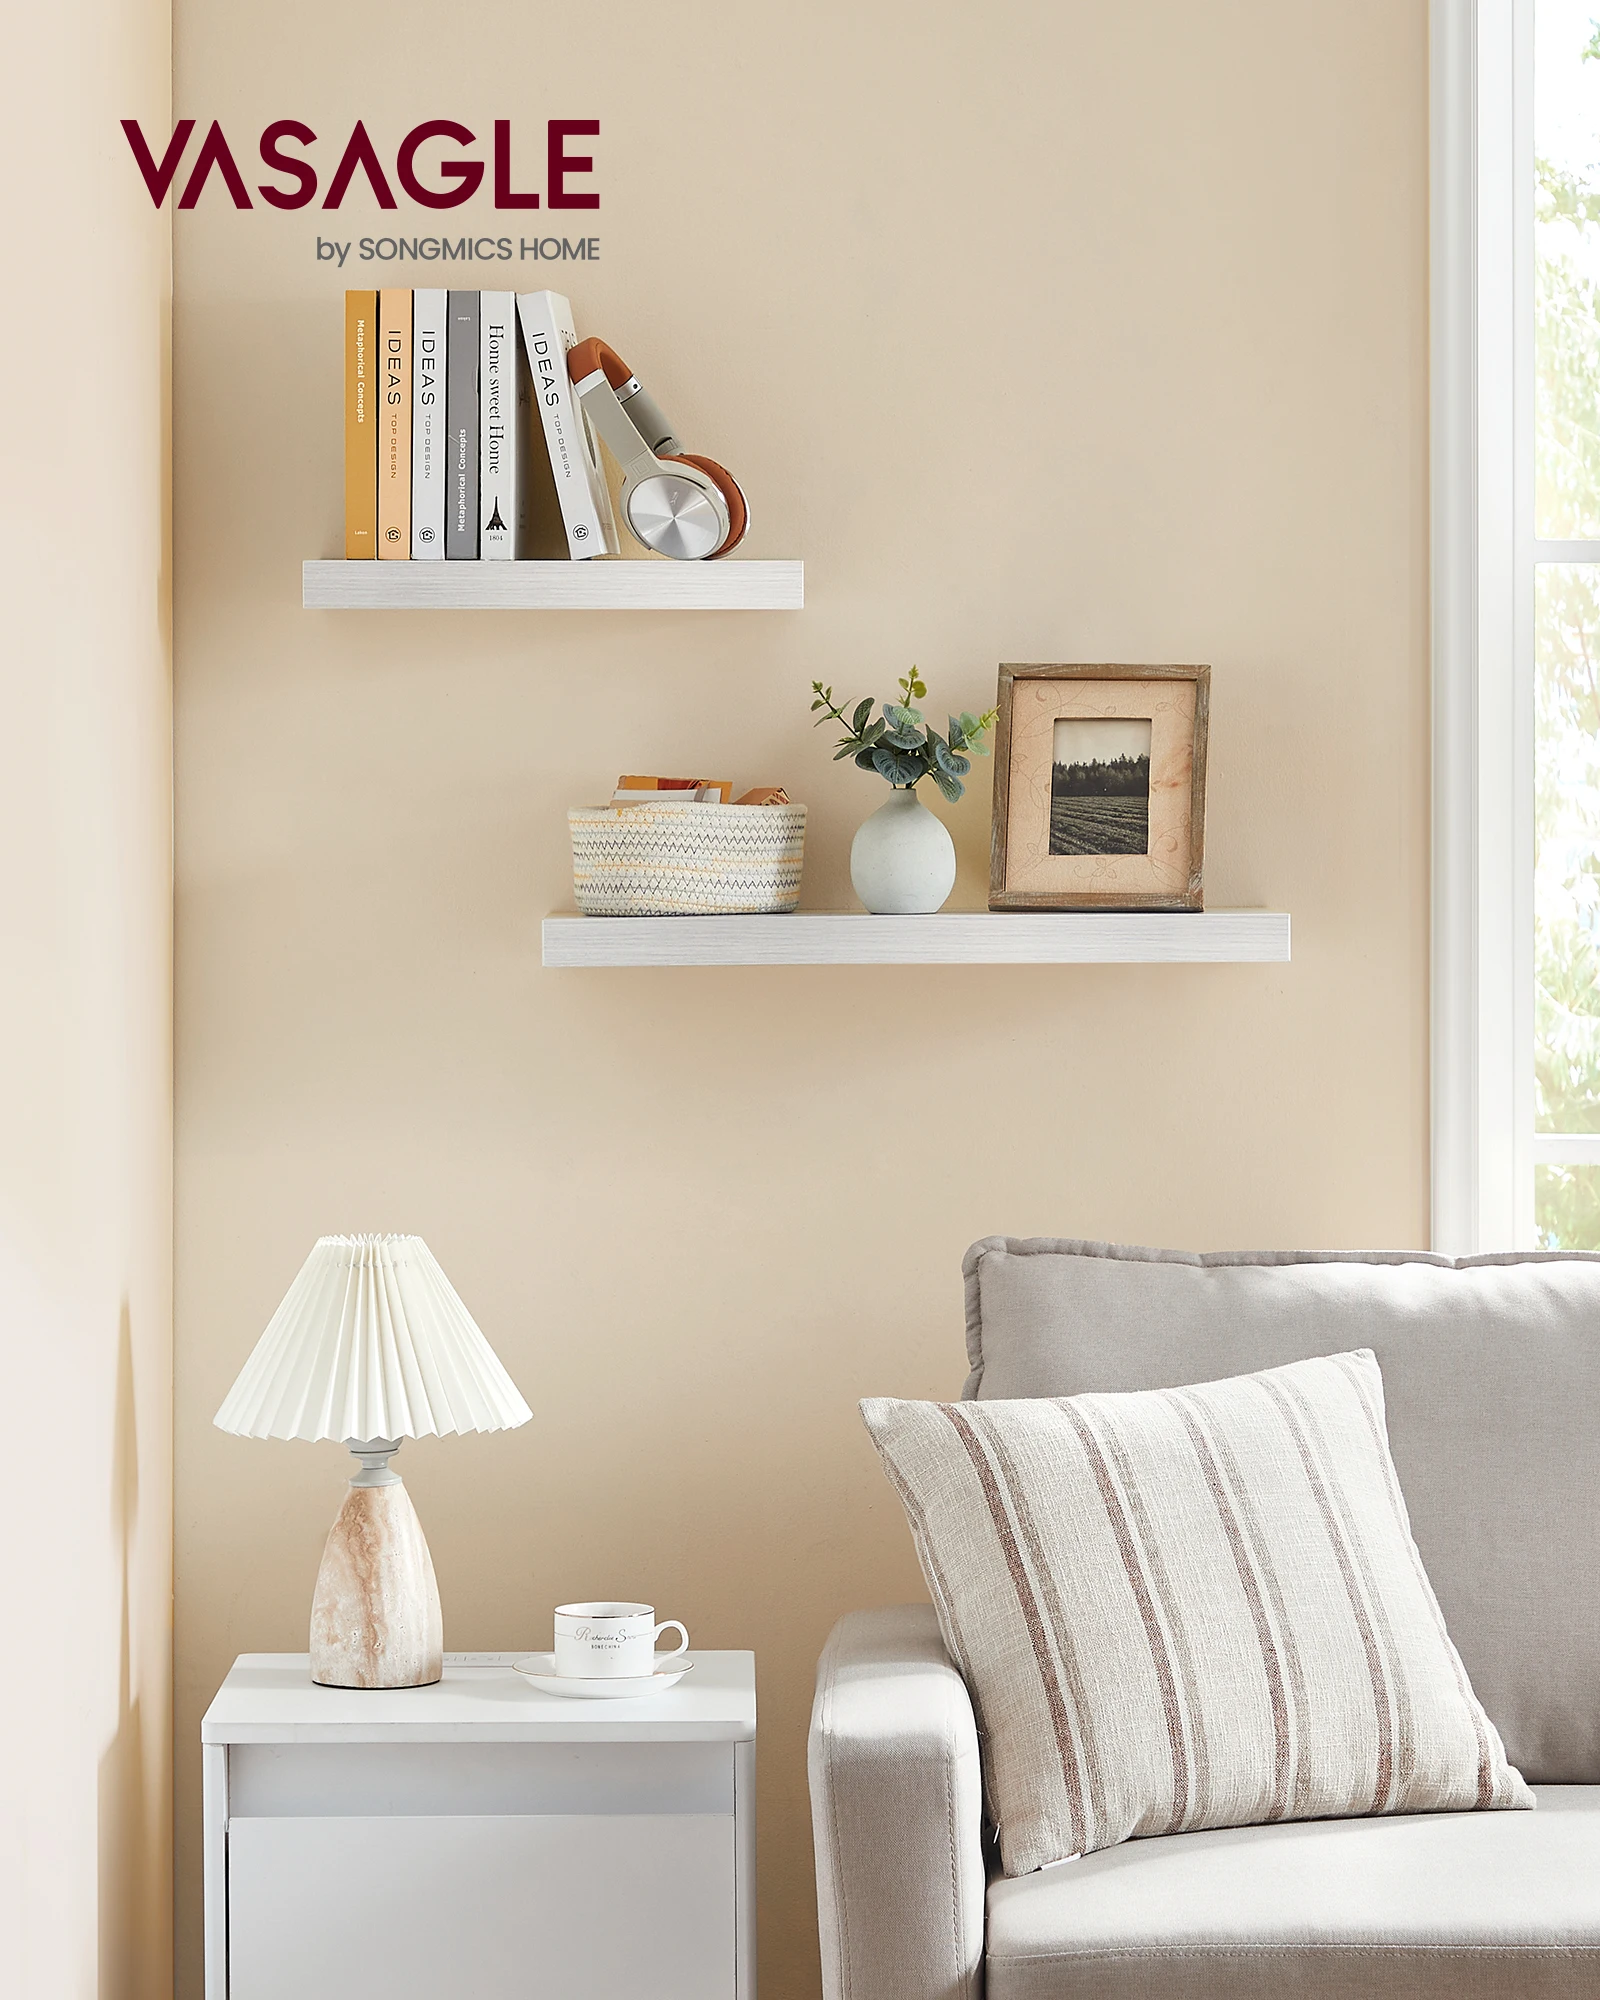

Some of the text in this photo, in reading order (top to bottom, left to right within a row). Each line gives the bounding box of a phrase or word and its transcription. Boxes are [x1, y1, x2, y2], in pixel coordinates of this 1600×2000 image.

[356, 319, 365, 423] Metaphorical Concepts
[387, 330, 401, 405] IDEAS
[421, 331, 436, 405] IDEAS
[489, 325, 505, 474] Home sweet Home
[532, 332, 560, 406] IDEAS
[457, 428, 467, 532] Metaphorical Concepts
[554, 413, 571, 478] TOP DESIGN
